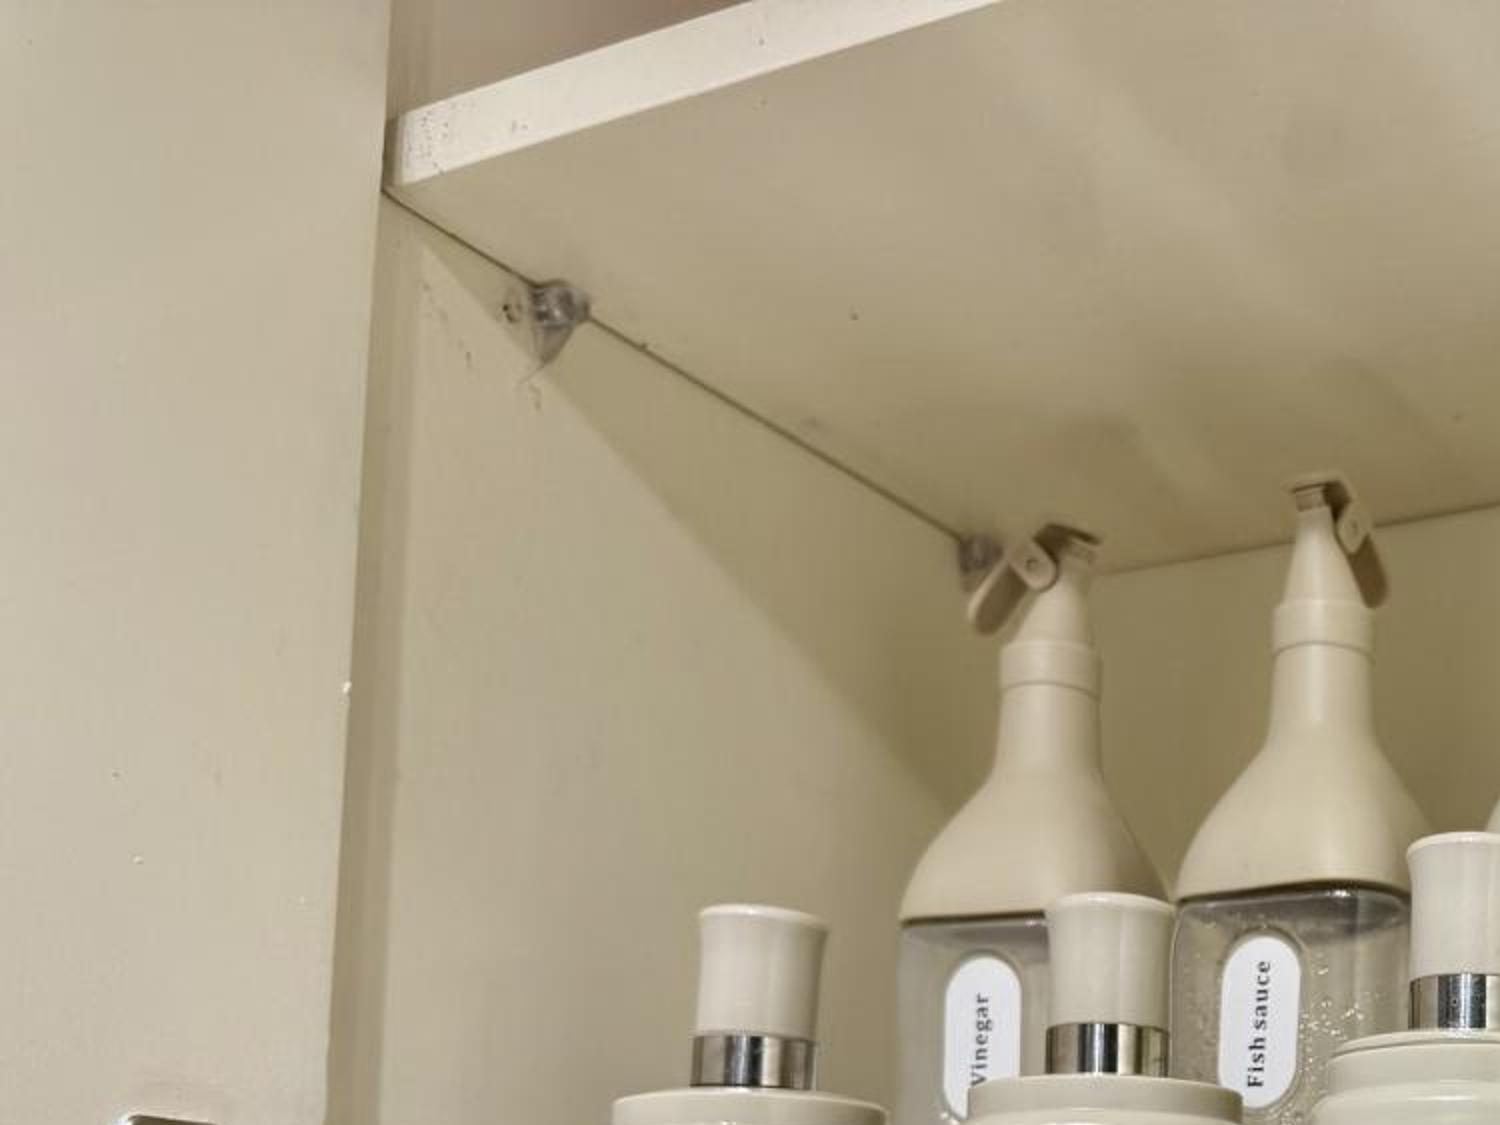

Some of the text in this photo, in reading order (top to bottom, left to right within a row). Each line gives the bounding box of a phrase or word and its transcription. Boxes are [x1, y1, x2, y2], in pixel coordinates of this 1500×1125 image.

[970, 992, 993, 1086] Vinegar
[1248, 961, 1271, 1088] Fish sauce
